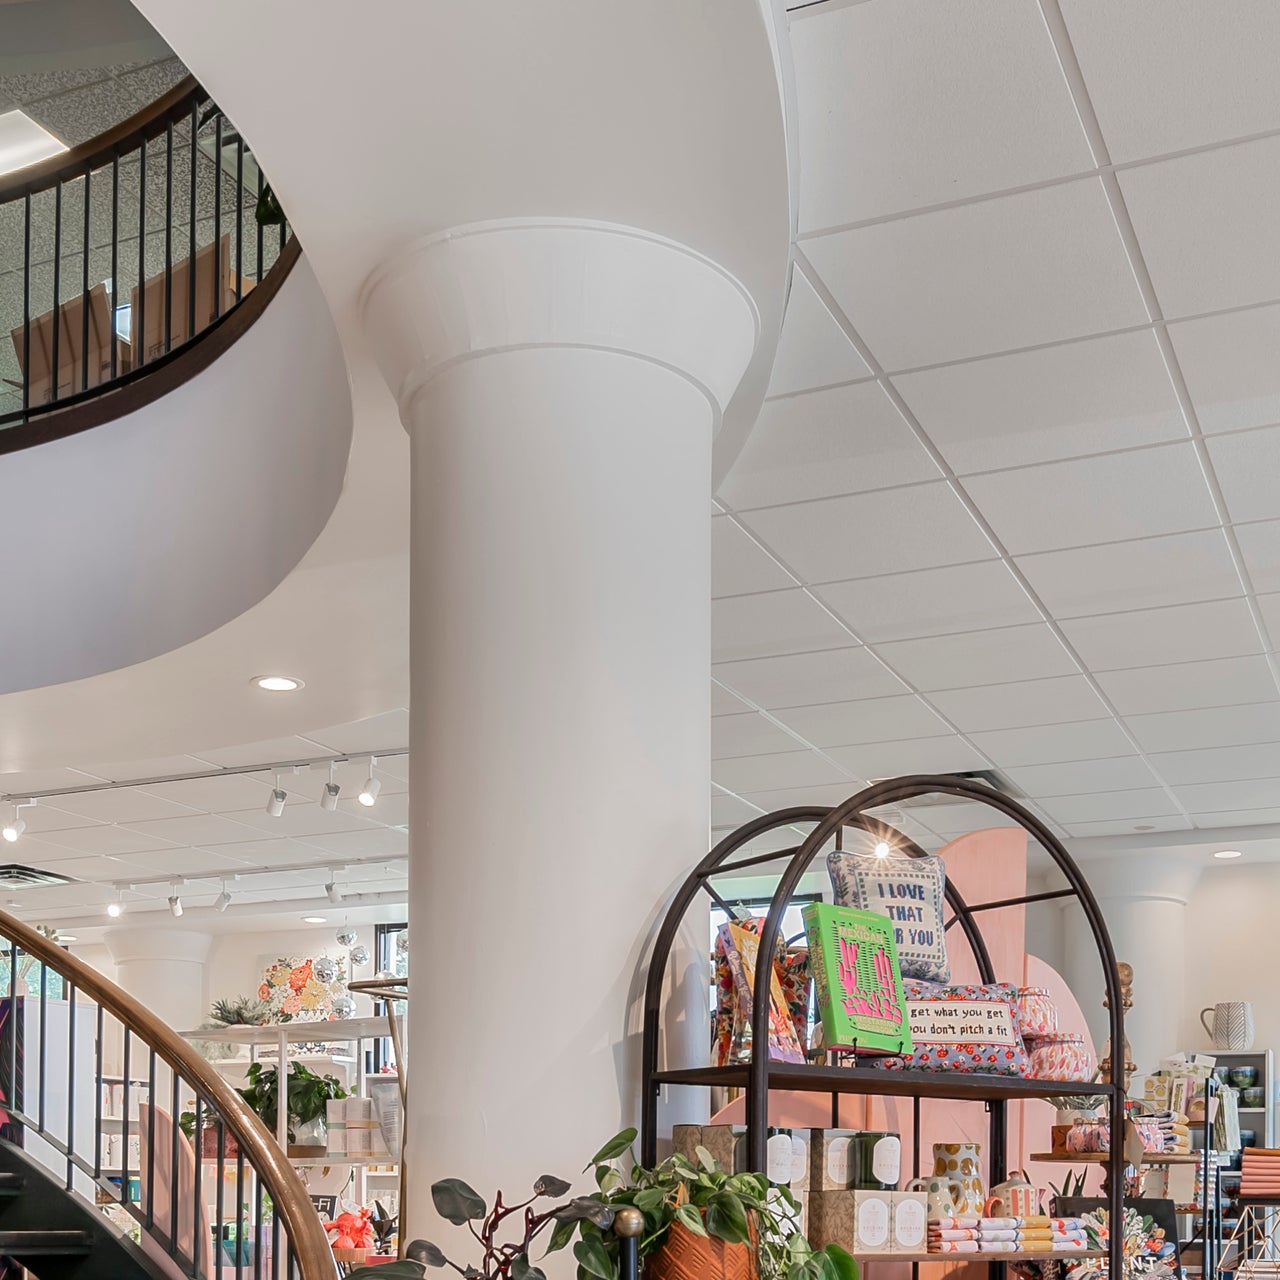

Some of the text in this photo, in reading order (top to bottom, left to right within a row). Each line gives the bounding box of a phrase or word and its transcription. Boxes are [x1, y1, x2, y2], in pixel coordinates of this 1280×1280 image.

[877, 883, 925, 900] I LOVE
[885, 905, 923, 922] THAT
[909, 928, 934, 946] YOU
[910, 1007, 1004, 1019] get what you get
[909, 1023, 1008, 1036] ou don't pitch a fit
[310, 1198, 331, 1210] -Fi
[1086, 1257, 1158, 1271] PLNT
